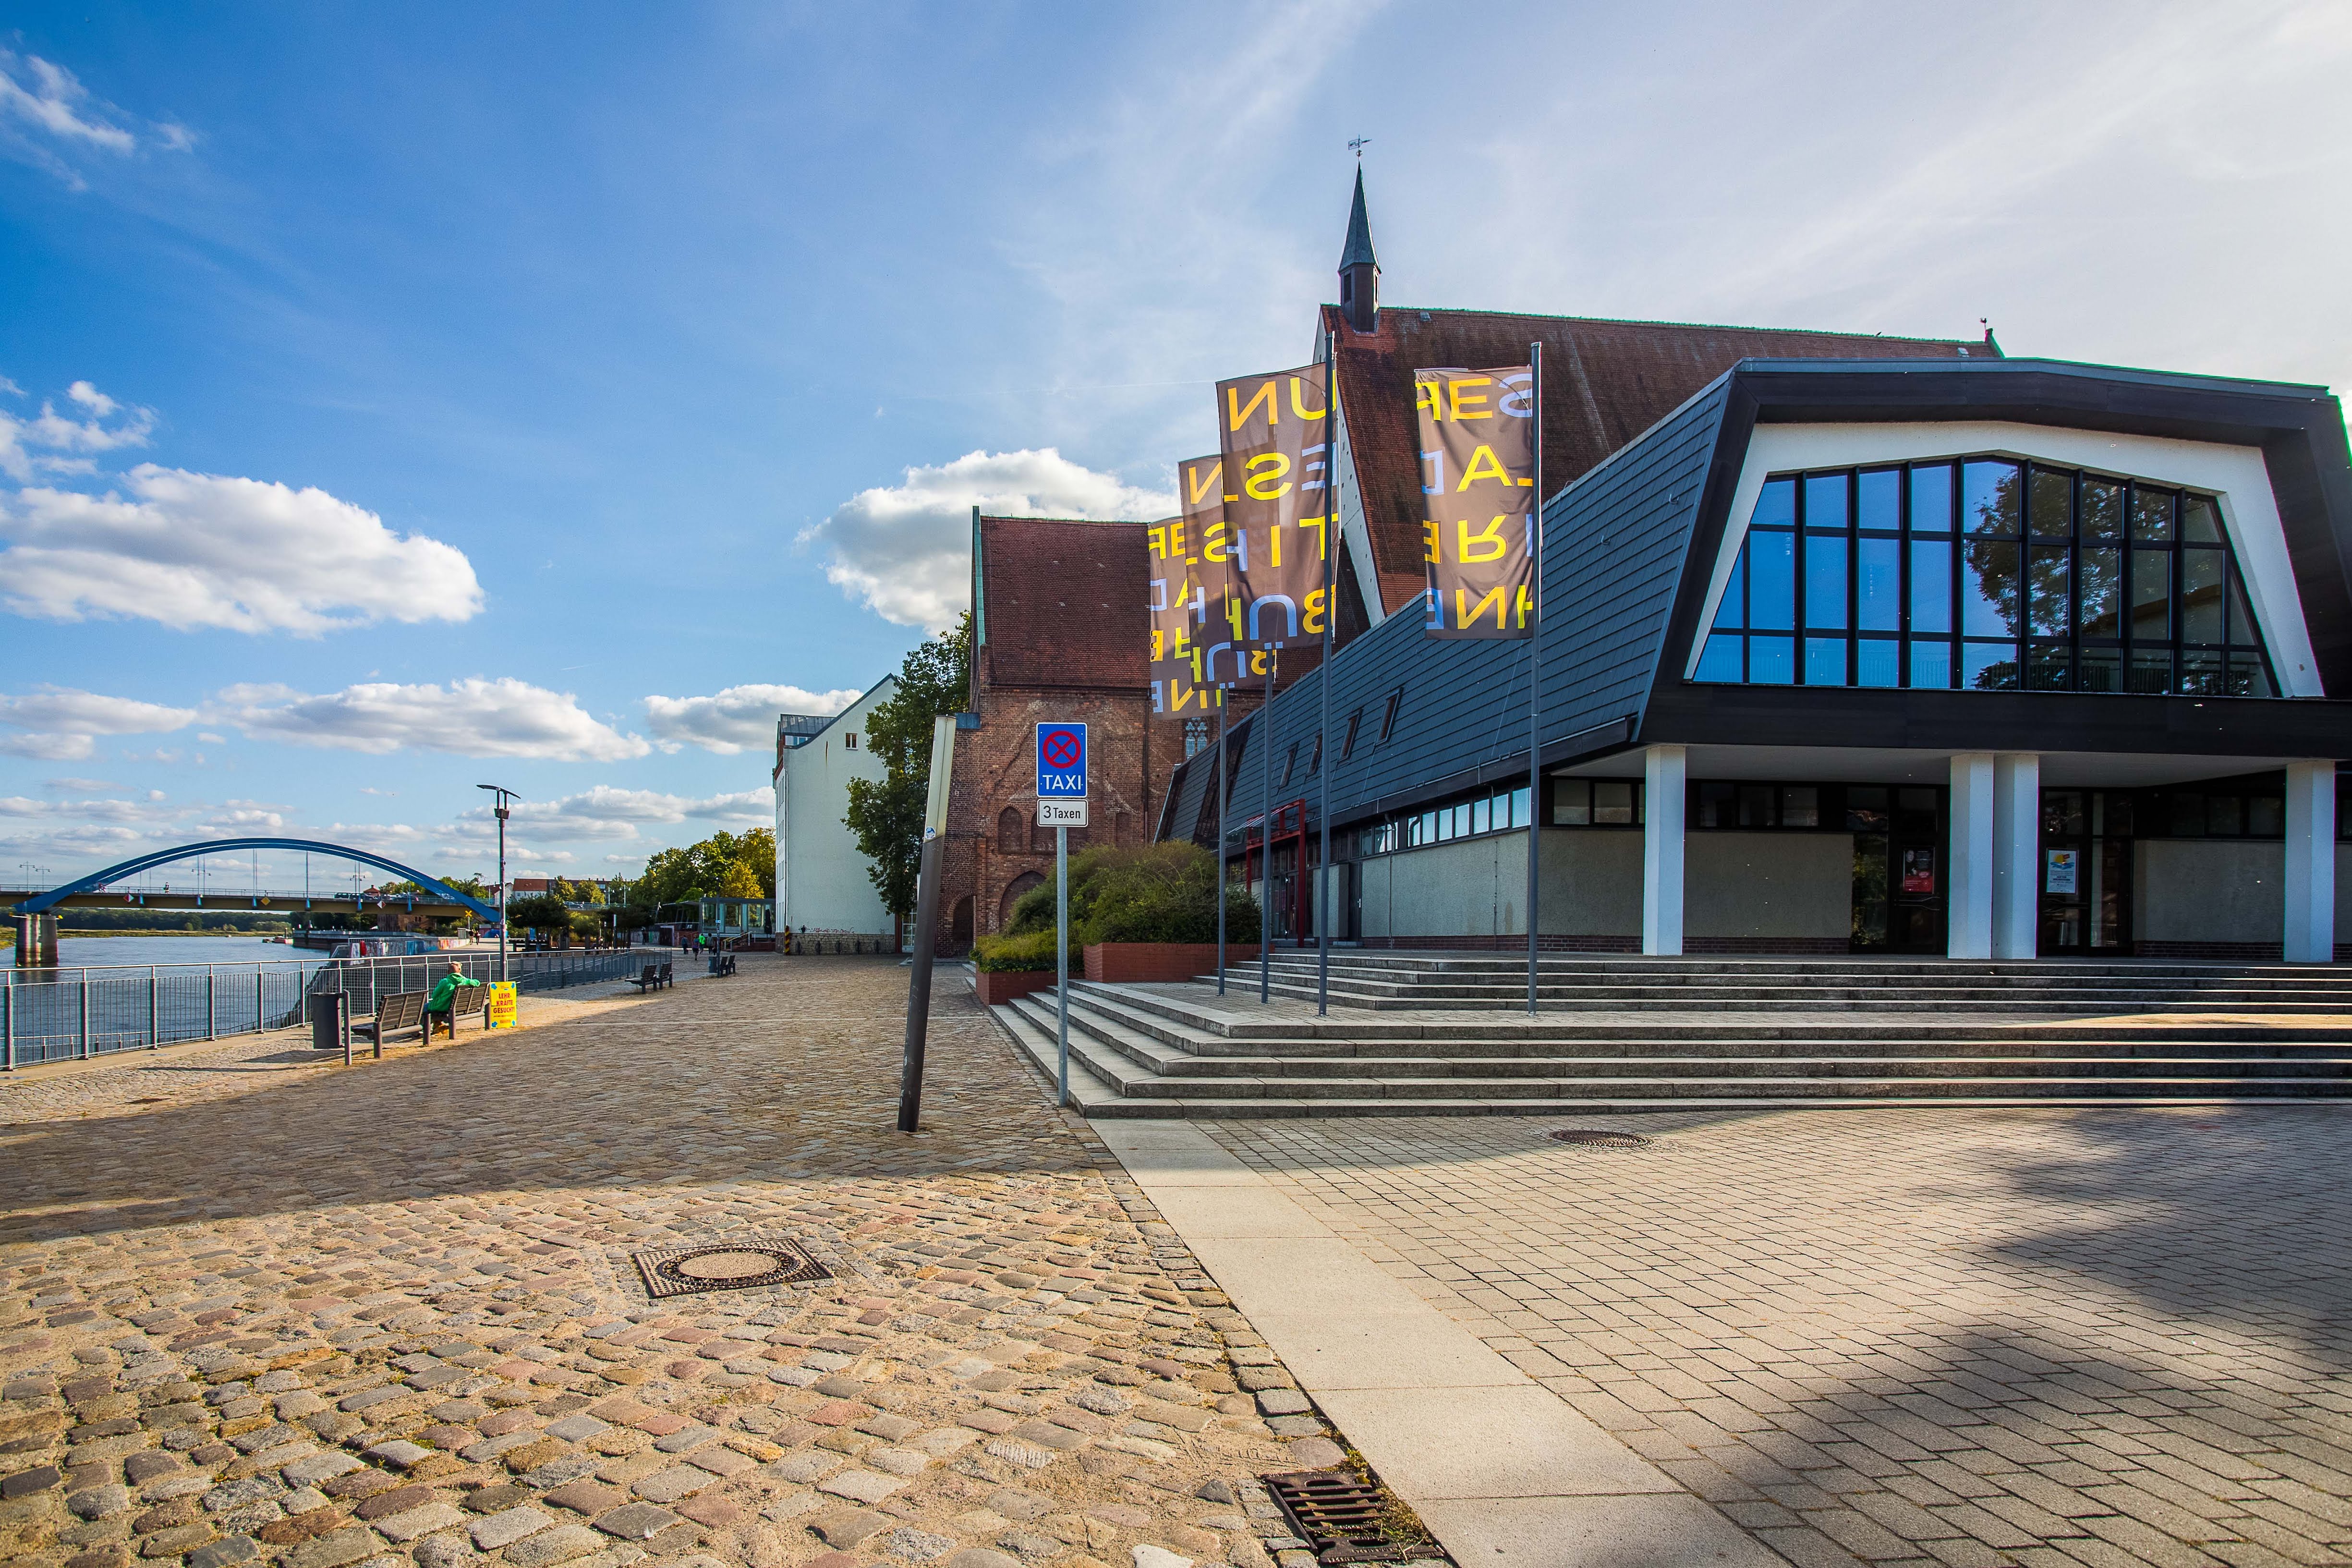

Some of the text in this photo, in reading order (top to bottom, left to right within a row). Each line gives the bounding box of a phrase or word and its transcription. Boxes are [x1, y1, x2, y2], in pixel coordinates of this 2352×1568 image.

[1043, 775, 1081, 790] TAXI
[1043, 805, 1080, 819] 3 Taxen
